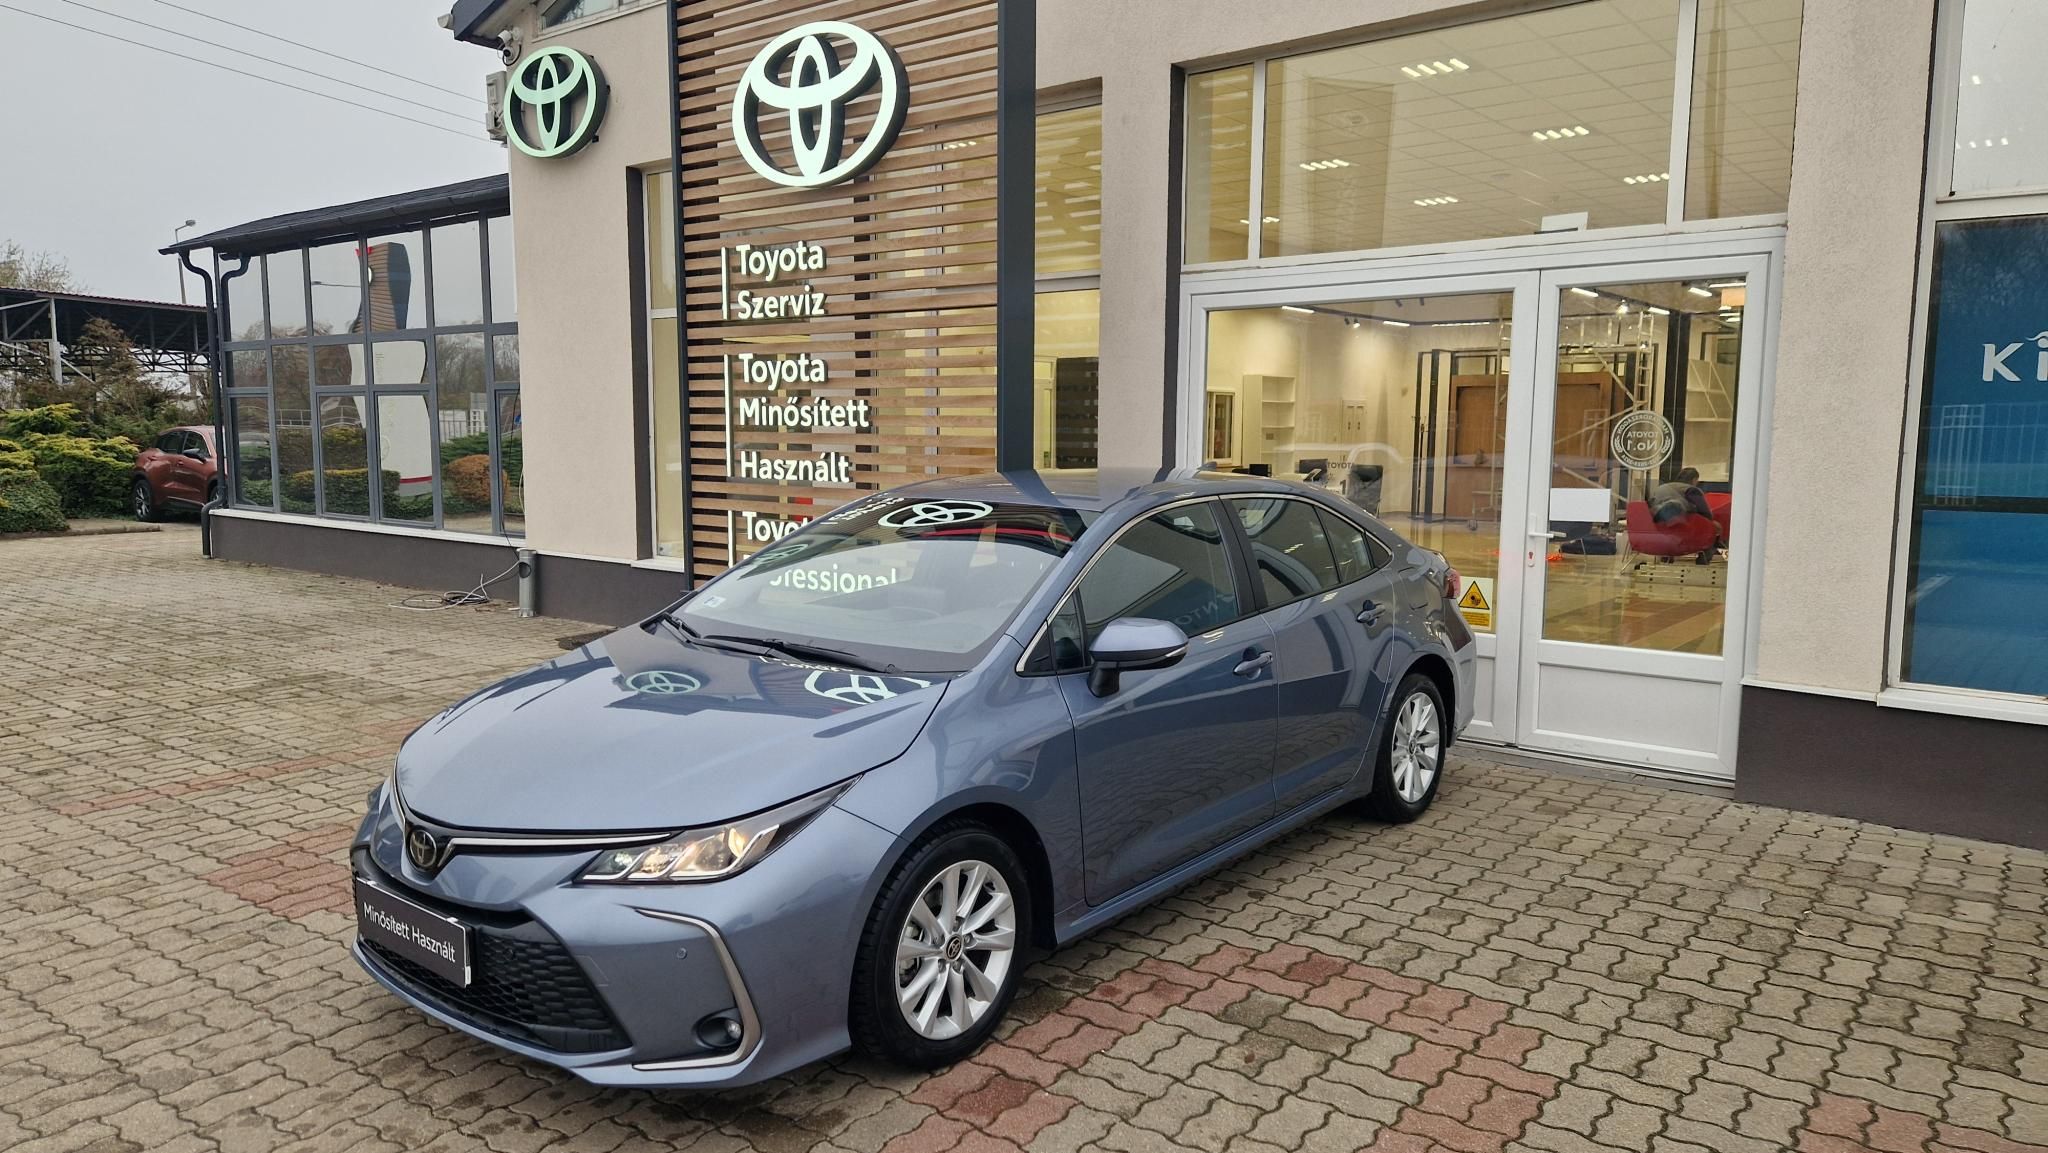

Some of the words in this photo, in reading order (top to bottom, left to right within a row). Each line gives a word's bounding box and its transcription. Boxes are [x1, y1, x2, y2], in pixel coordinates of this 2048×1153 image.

[735, 241, 824, 281] Toyota
[737, 285, 825, 320] Szerviz
[738, 353, 826, 390] Toyota
[739, 396, 869, 428] Minősített
[740, 450, 850, 483] Használt
[742, 510, 808, 541] Toyo
[769, 562, 897, 594] fessional
[363, 902, 410, 940] Minősített
[412, 925, 456, 963] Használt
